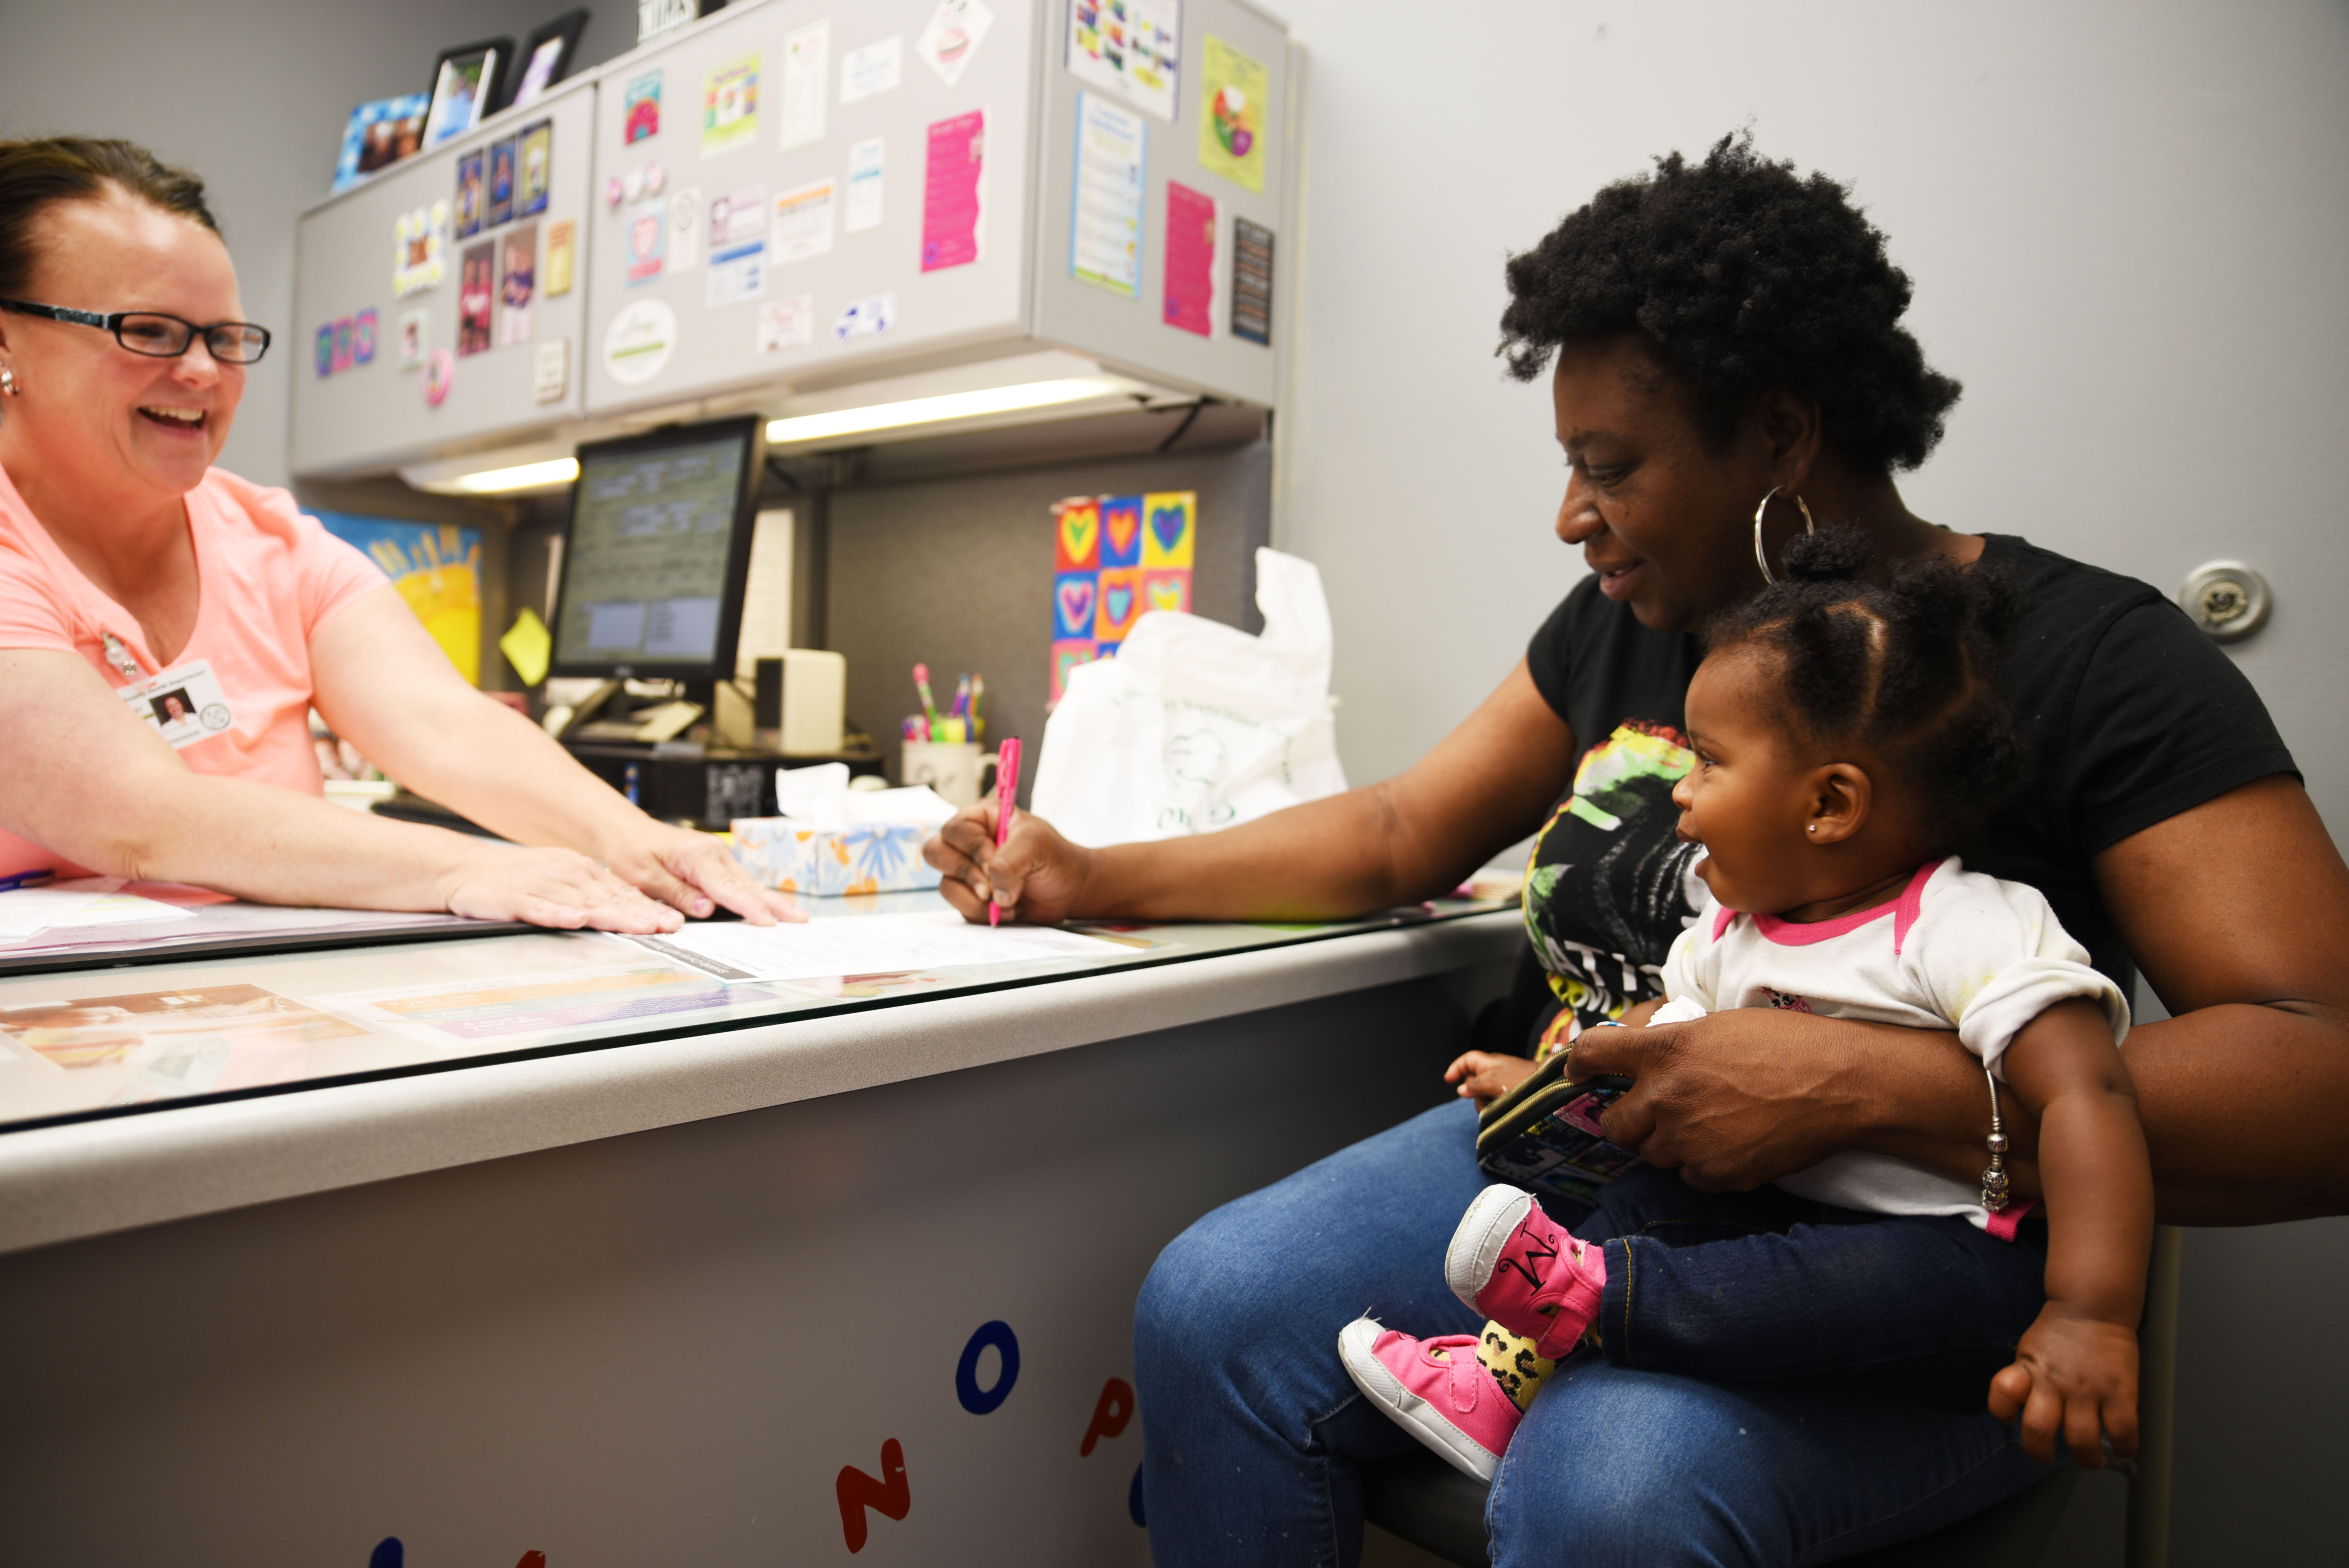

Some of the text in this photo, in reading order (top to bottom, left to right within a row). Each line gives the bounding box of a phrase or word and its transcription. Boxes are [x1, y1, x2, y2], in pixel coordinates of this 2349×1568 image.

[956, 1320, 1020, 1415] O
[1080, 1376, 1135, 1458] P
[836, 1438, 911, 1554] N
